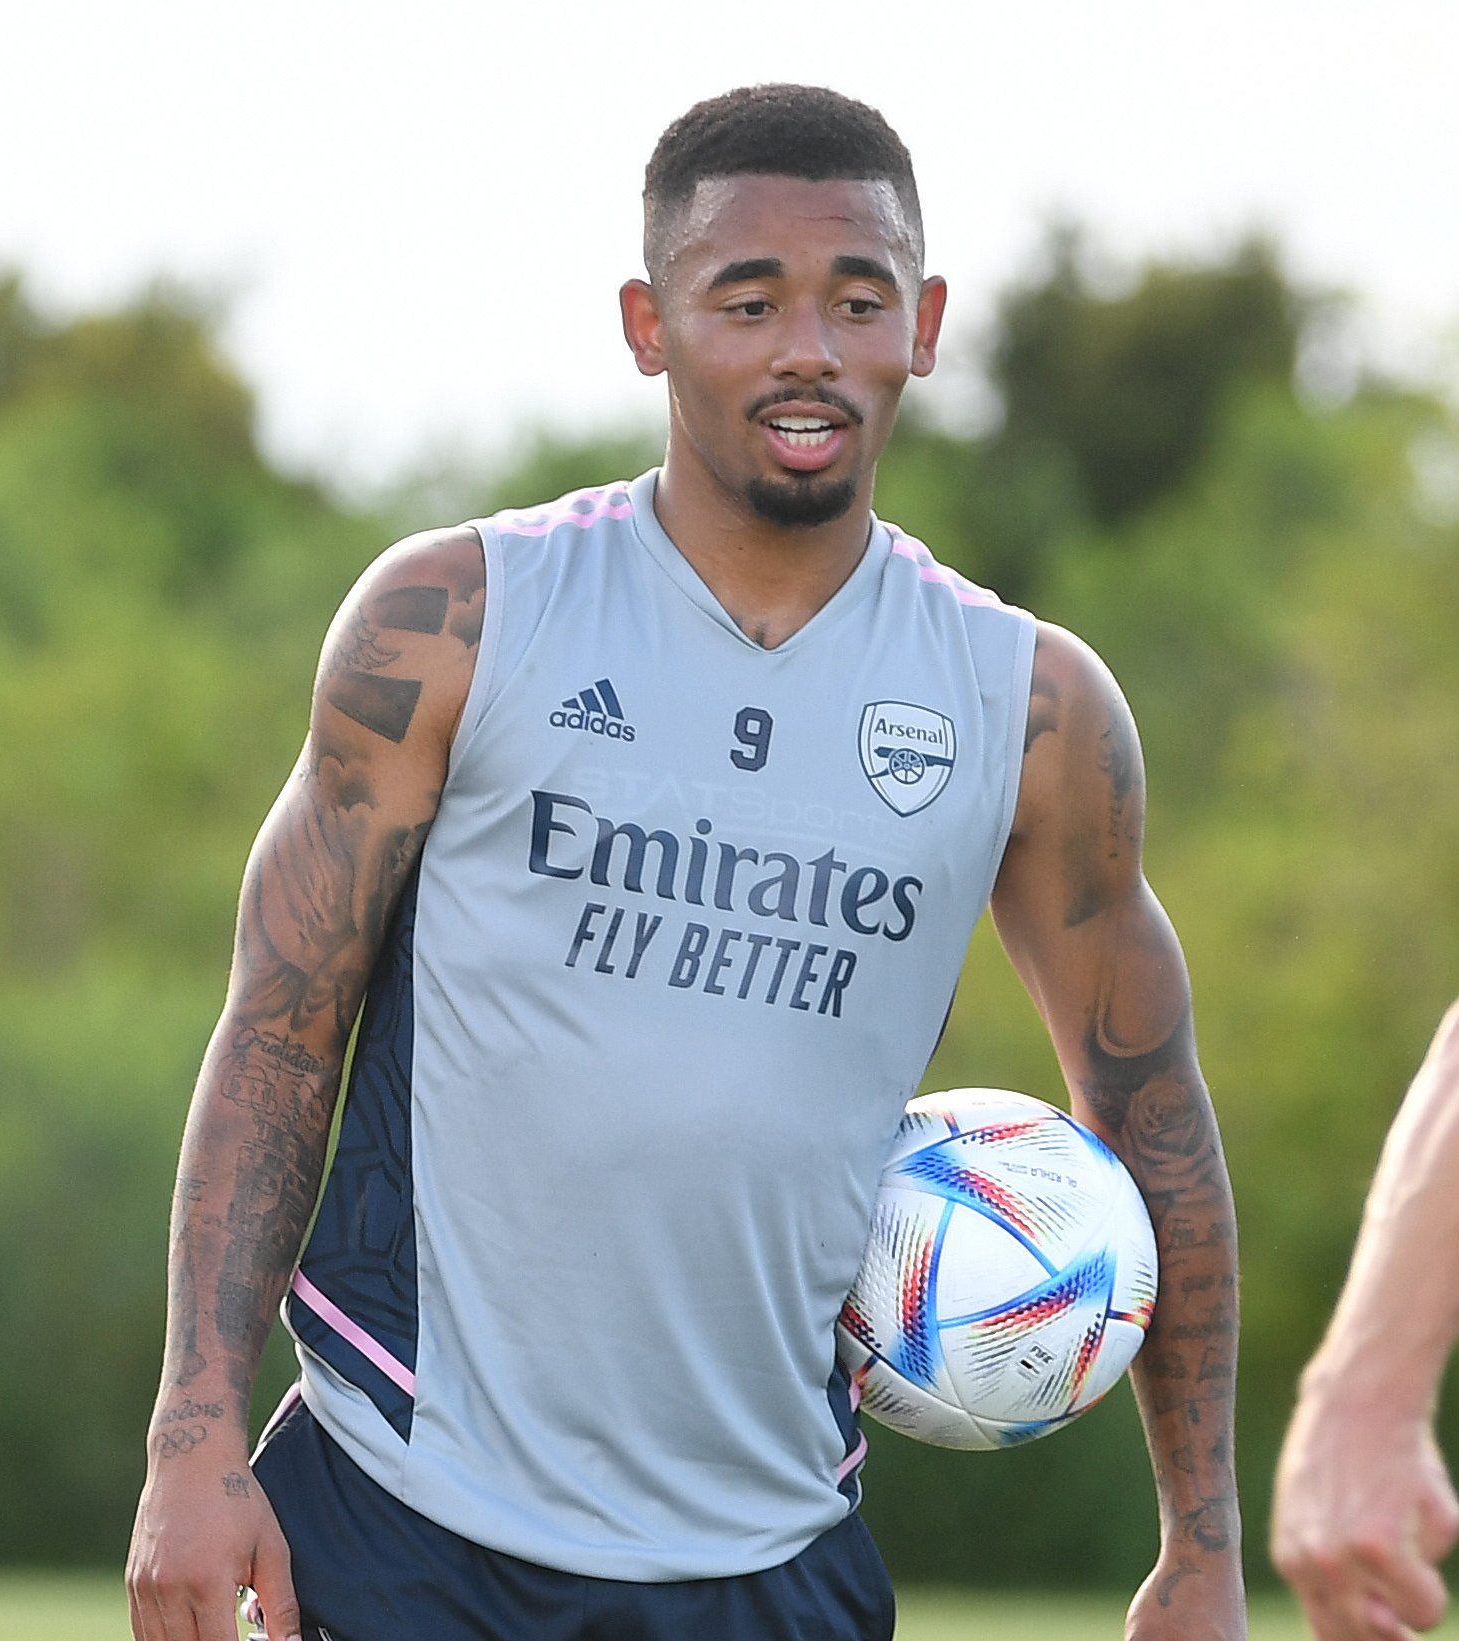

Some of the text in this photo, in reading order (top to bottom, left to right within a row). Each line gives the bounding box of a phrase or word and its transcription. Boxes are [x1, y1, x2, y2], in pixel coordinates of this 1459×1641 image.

[549, 707, 635, 743] adidas
[729, 706, 774, 773] 9
[874, 717, 944, 746] Arsenal
[528, 789, 924, 942] Emirates
[564, 902, 858, 1019] FLY BETTER
